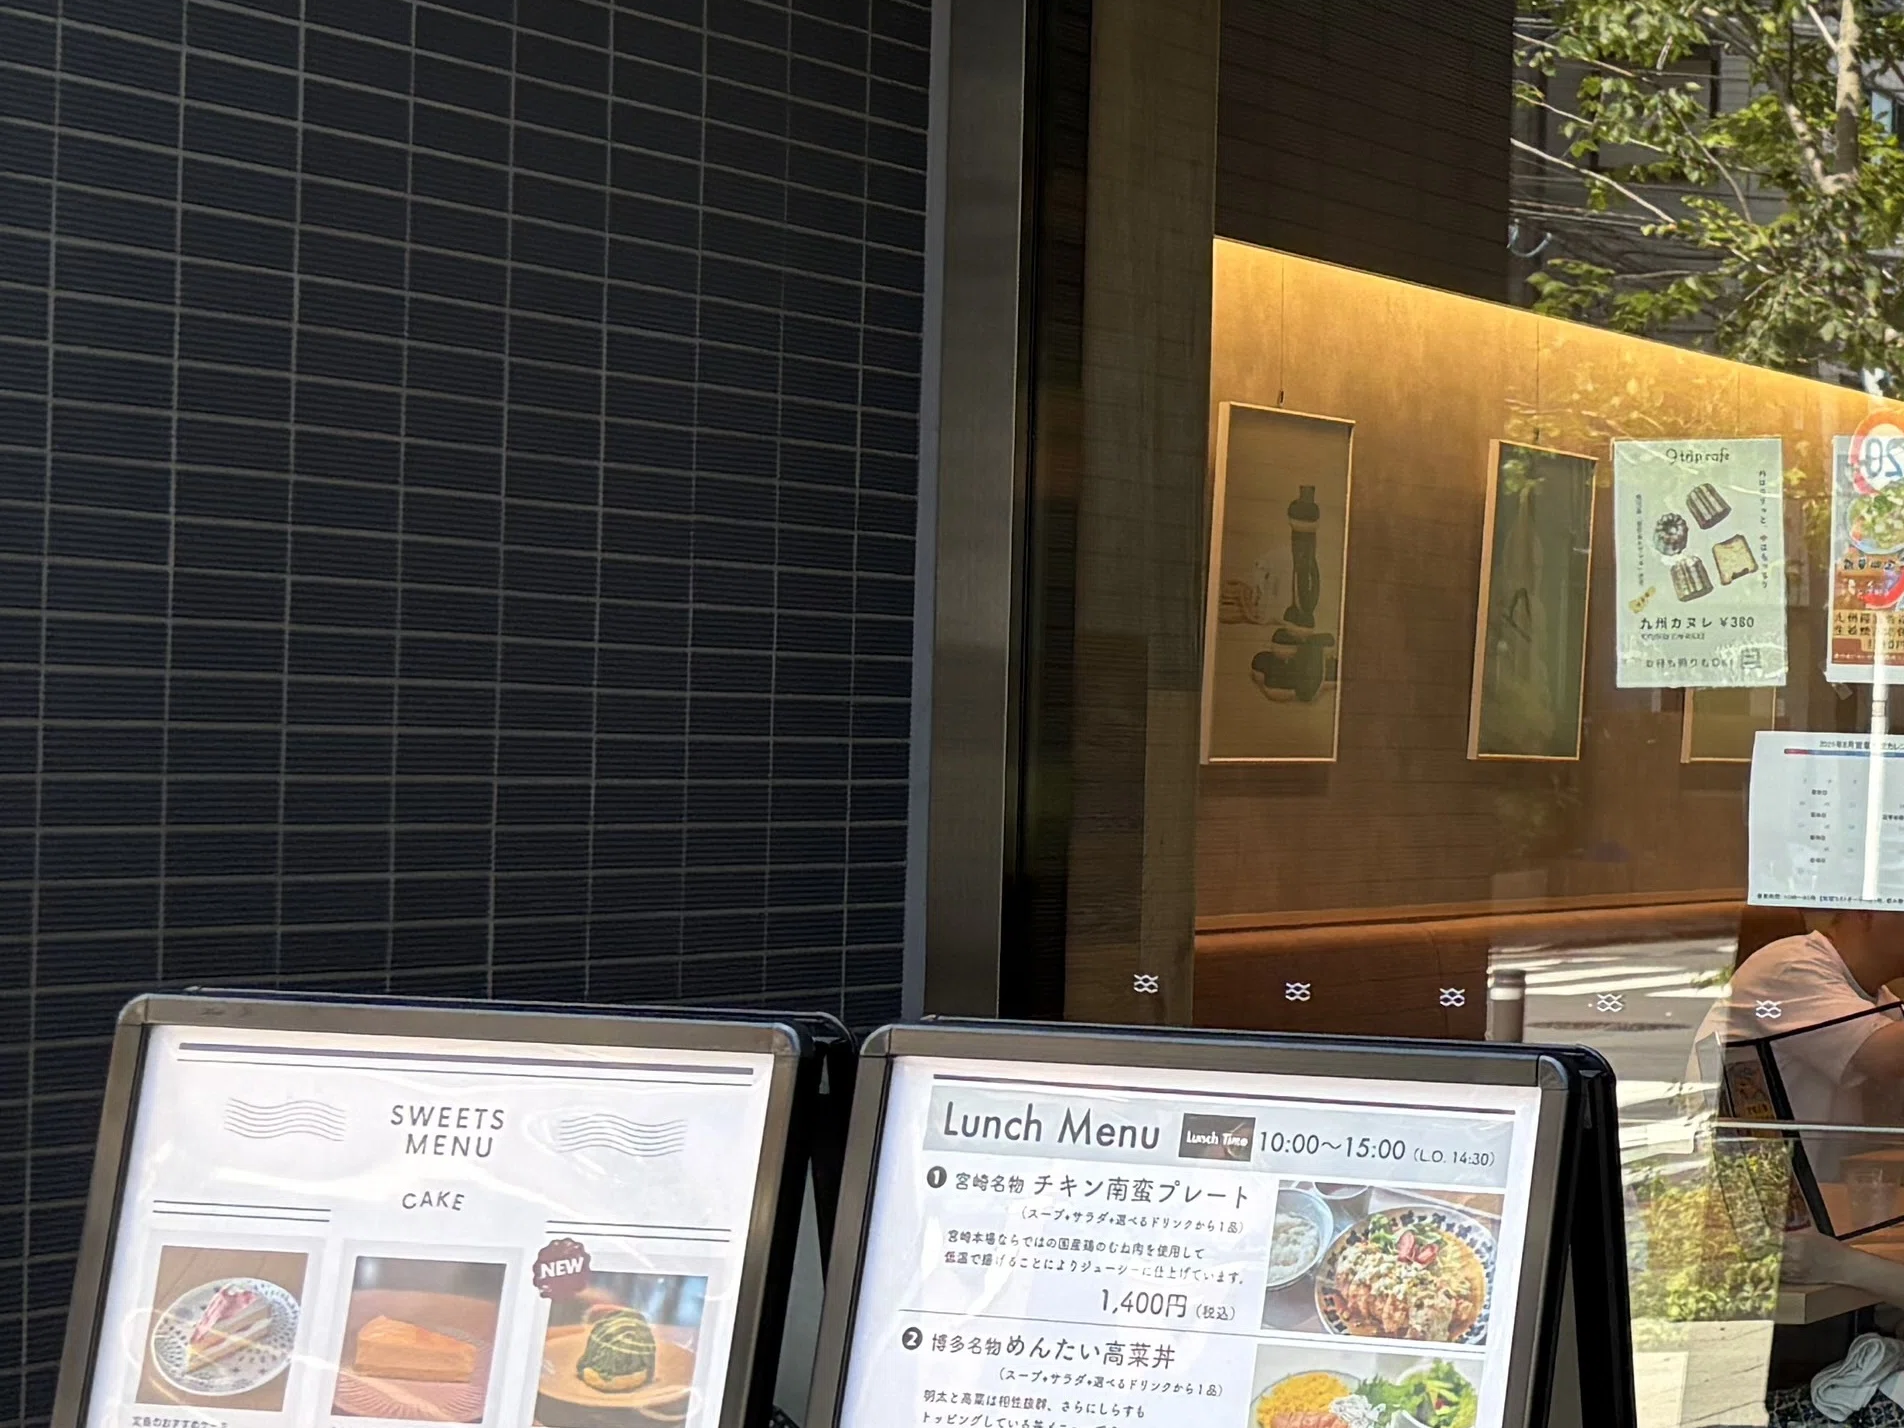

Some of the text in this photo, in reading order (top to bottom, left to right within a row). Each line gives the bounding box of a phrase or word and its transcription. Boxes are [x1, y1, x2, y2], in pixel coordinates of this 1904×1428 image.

[389, 1103, 505, 1130] SWEETS
[942, 1099, 1162, 1149] Lunch Menu
[404, 1133, 493, 1158] MENU
[401, 1189, 465, 1212] CAKE
[954, 1171, 1025, 1193] 宮崎名物
[1032, 1172, 1249, 1209] チキン南蛮プレート
[539, 1253, 585, 1280] NEW
[1098, 1289, 1188, 1320] 1,400円
[930, 1333, 1002, 1356] 博多名物
[1004, 1334, 1176, 1370] めんたい高菜丼
